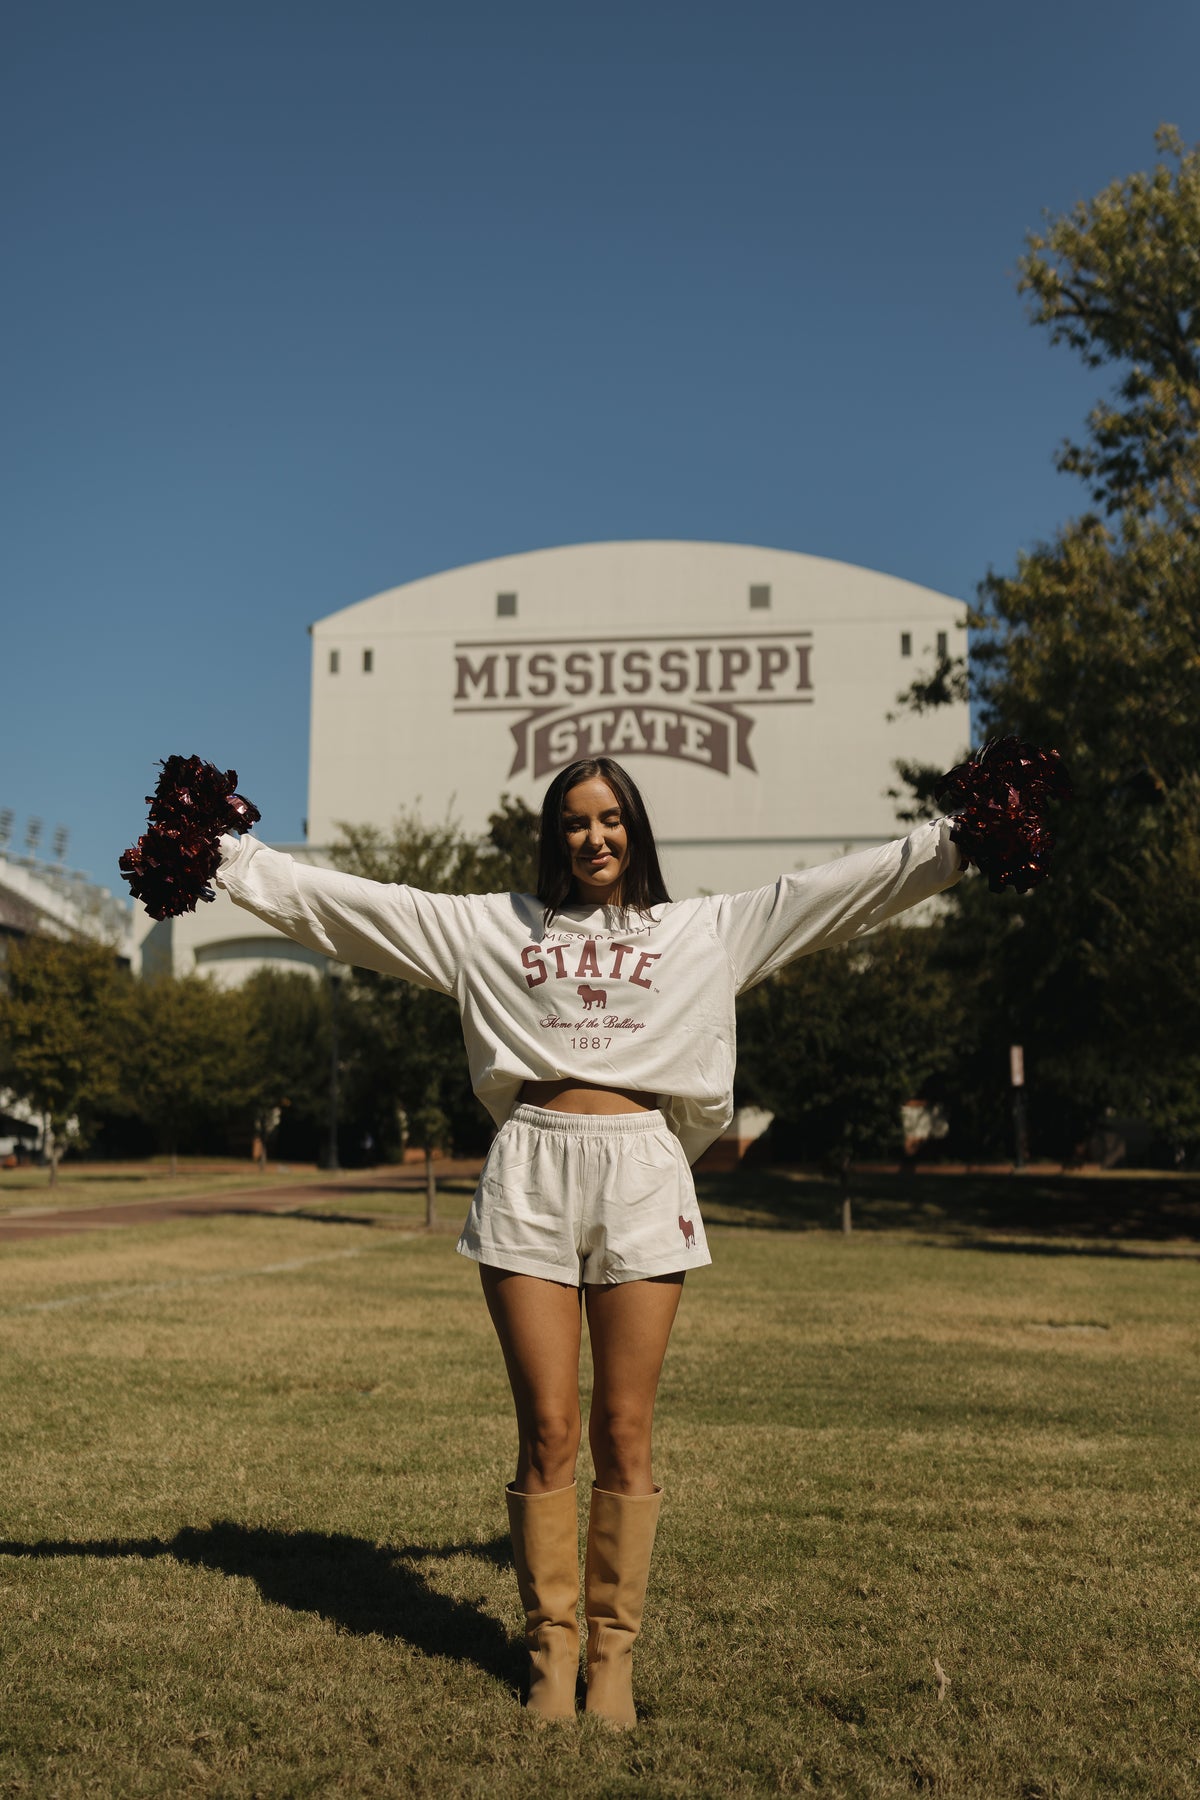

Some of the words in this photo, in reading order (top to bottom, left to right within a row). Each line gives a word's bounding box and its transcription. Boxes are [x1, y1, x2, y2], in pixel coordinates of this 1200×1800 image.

[454, 645, 814, 699] MISSISSIPPI
[550, 710, 712, 765] STATE
[520, 939, 662, 989] STATE
[540, 1014, 572, 1029] Home
[574, 1018, 588, 1031] of
[586, 1018, 600, 1029] the
[603, 1015, 646, 1033] Bulldogs
[570, 1037, 612, 1049] 1887
